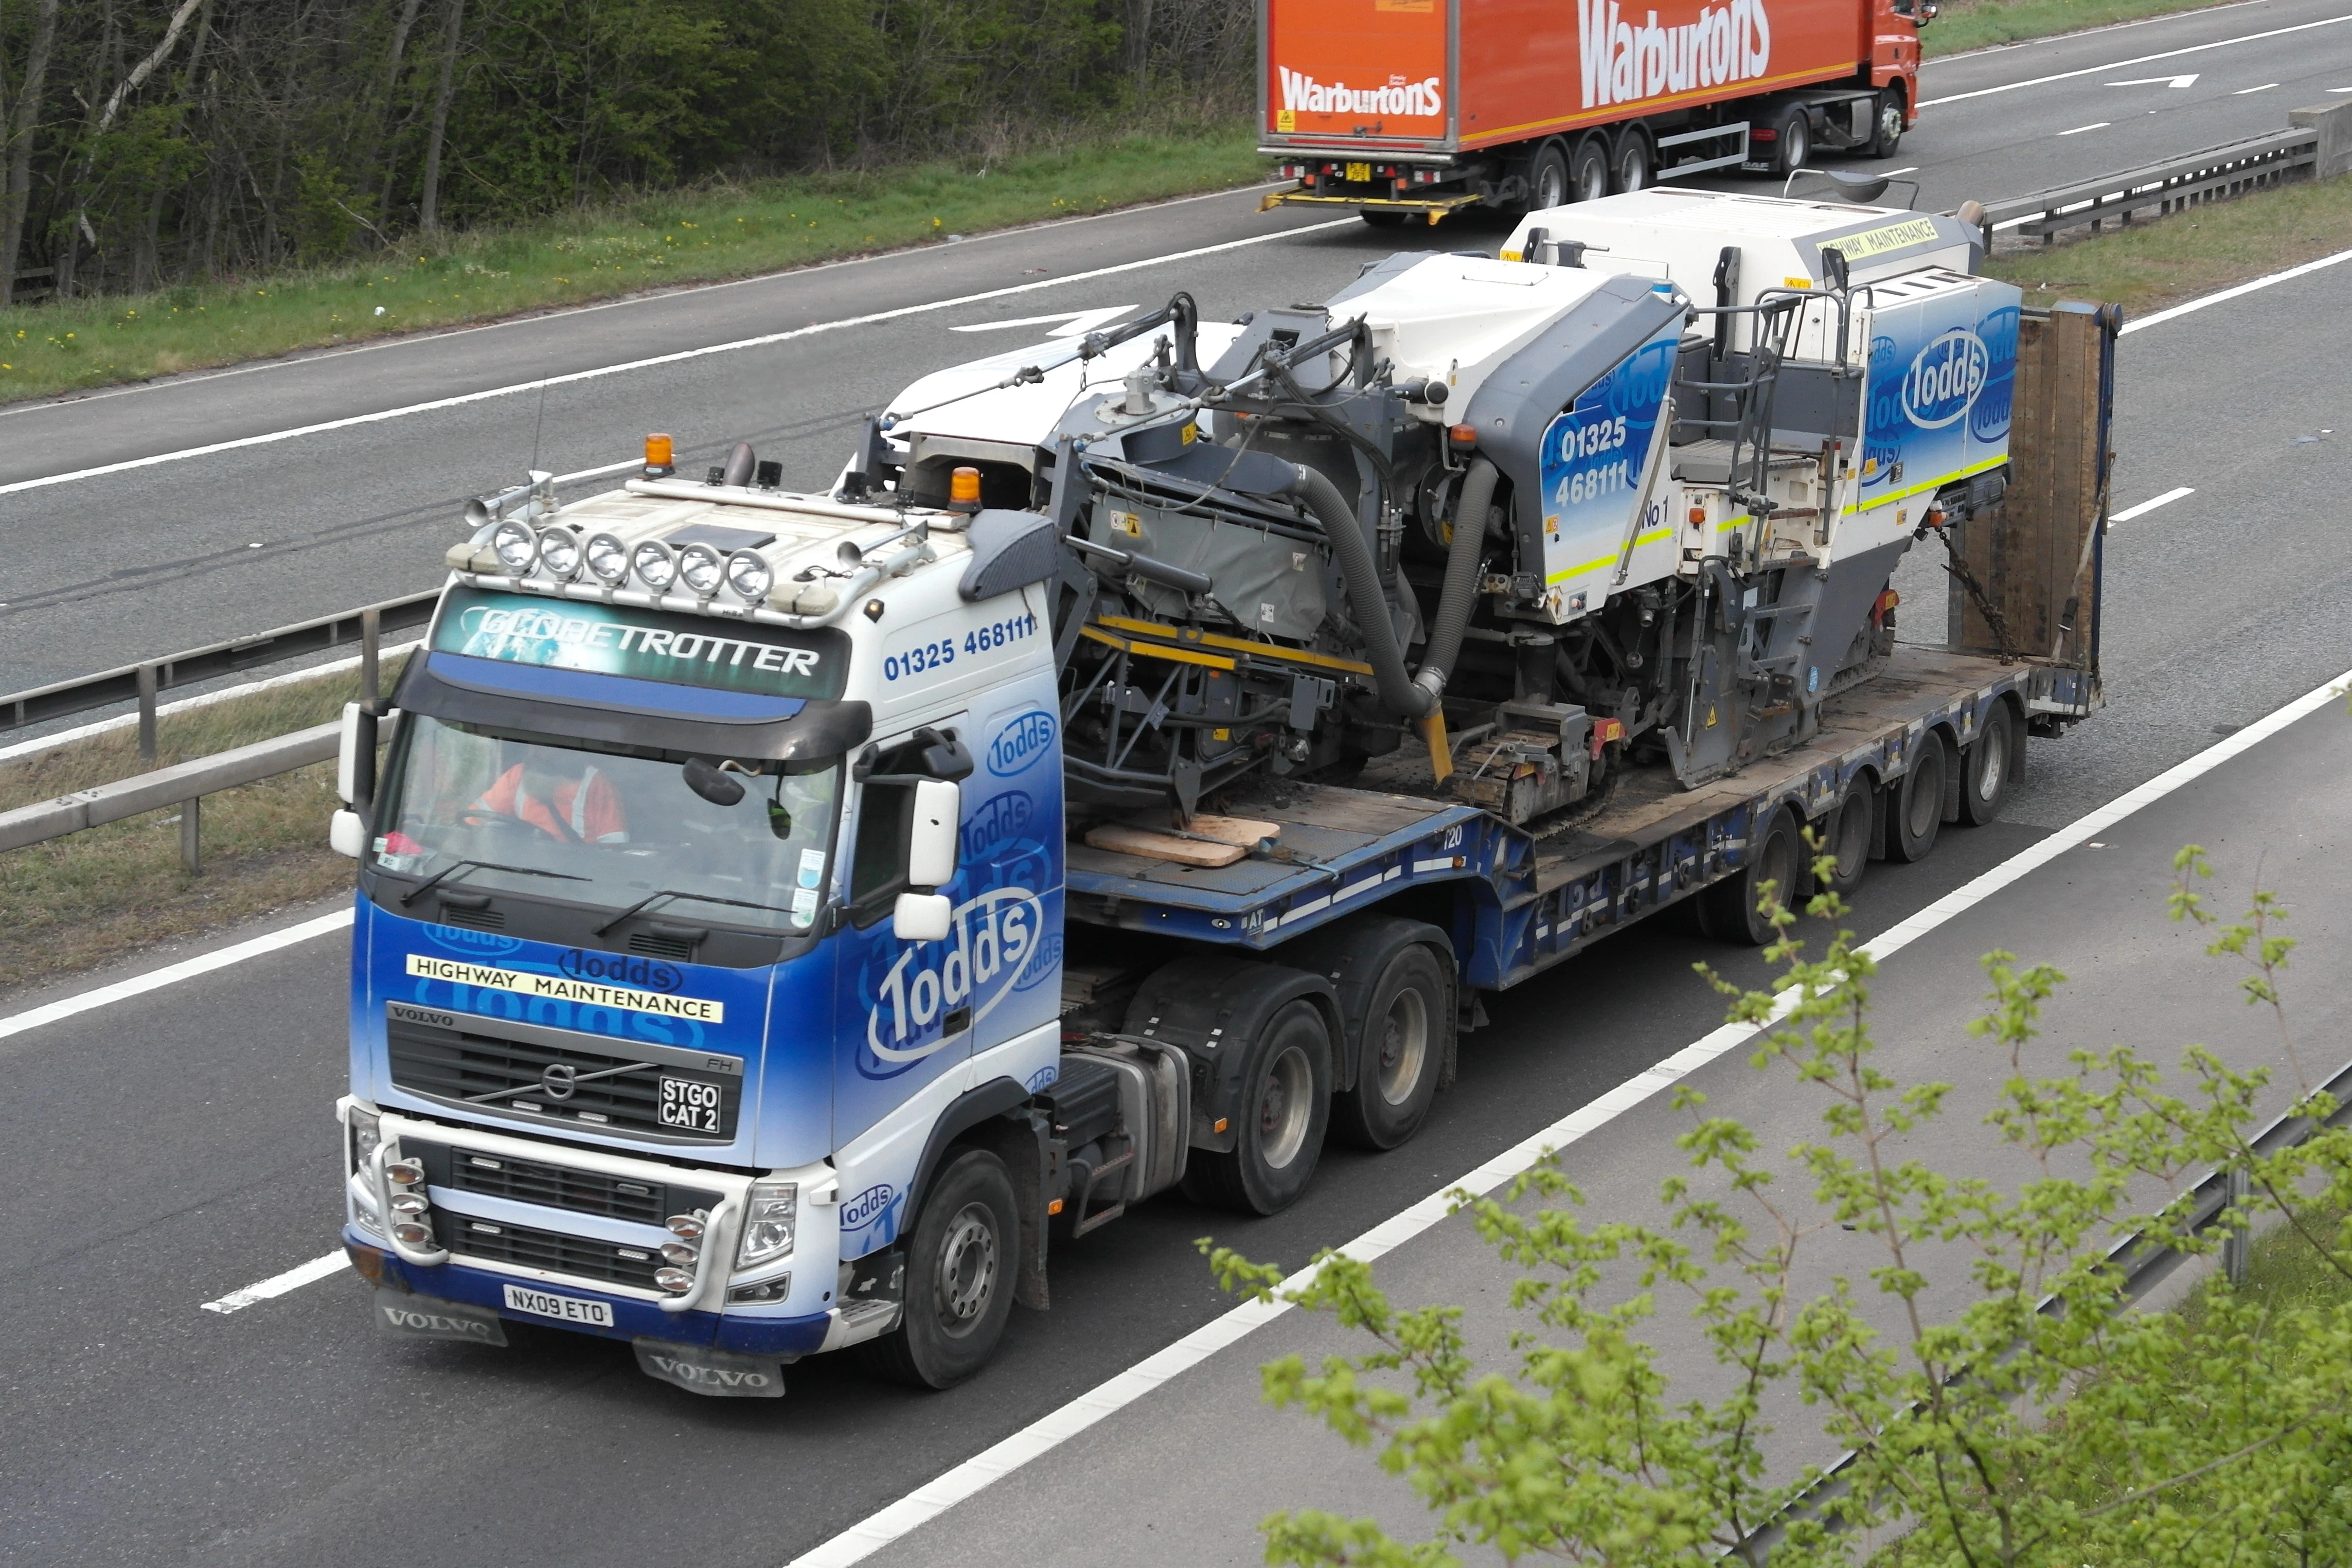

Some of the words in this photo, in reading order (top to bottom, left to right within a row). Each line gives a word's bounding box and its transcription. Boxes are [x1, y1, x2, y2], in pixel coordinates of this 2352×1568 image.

[1577, 0, 1771, 109] Warburtons
[1278, 65, 1441, 116] Warburtons
[1865, 220, 1935, 251] MAINTENANCE
[1910, 337, 1980, 409] Todds
[1562, 416, 1626, 462] 01325
[1556, 459, 1627, 507] 468111
[1642, 500, 1660, 529] No
[1663, 495, 1668, 523] 1
[477, 609, 820, 676] GLOBETROTTER
[883, 639, 955, 681] 01325
[964, 612, 1034, 655] 468111
[990, 713, 1051, 770] Todds
[960, 795, 1027, 861] Todds
[417, 958, 518, 988] HIGHWAY
[535, 978, 711, 1019] MAINTENANCE
[568, 949, 670, 988] Todds
[879, 898, 1028, 1043] Todds
[391, 1006, 454, 1026] VOLVO
[706, 1058, 733, 1072] FH
[663, 1080, 717, 1108] STGO
[662, 1102, 701, 1127] CAT
[704, 1109, 716, 1130] 2
[840, 1186, 888, 1226] Todds
[382, 1306, 490, 1335] VOLVO
[512, 1289, 561, 1315] NX09
[565, 1300, 604, 1322] ETO
[648, 1355, 769, 1387] VOLVO
